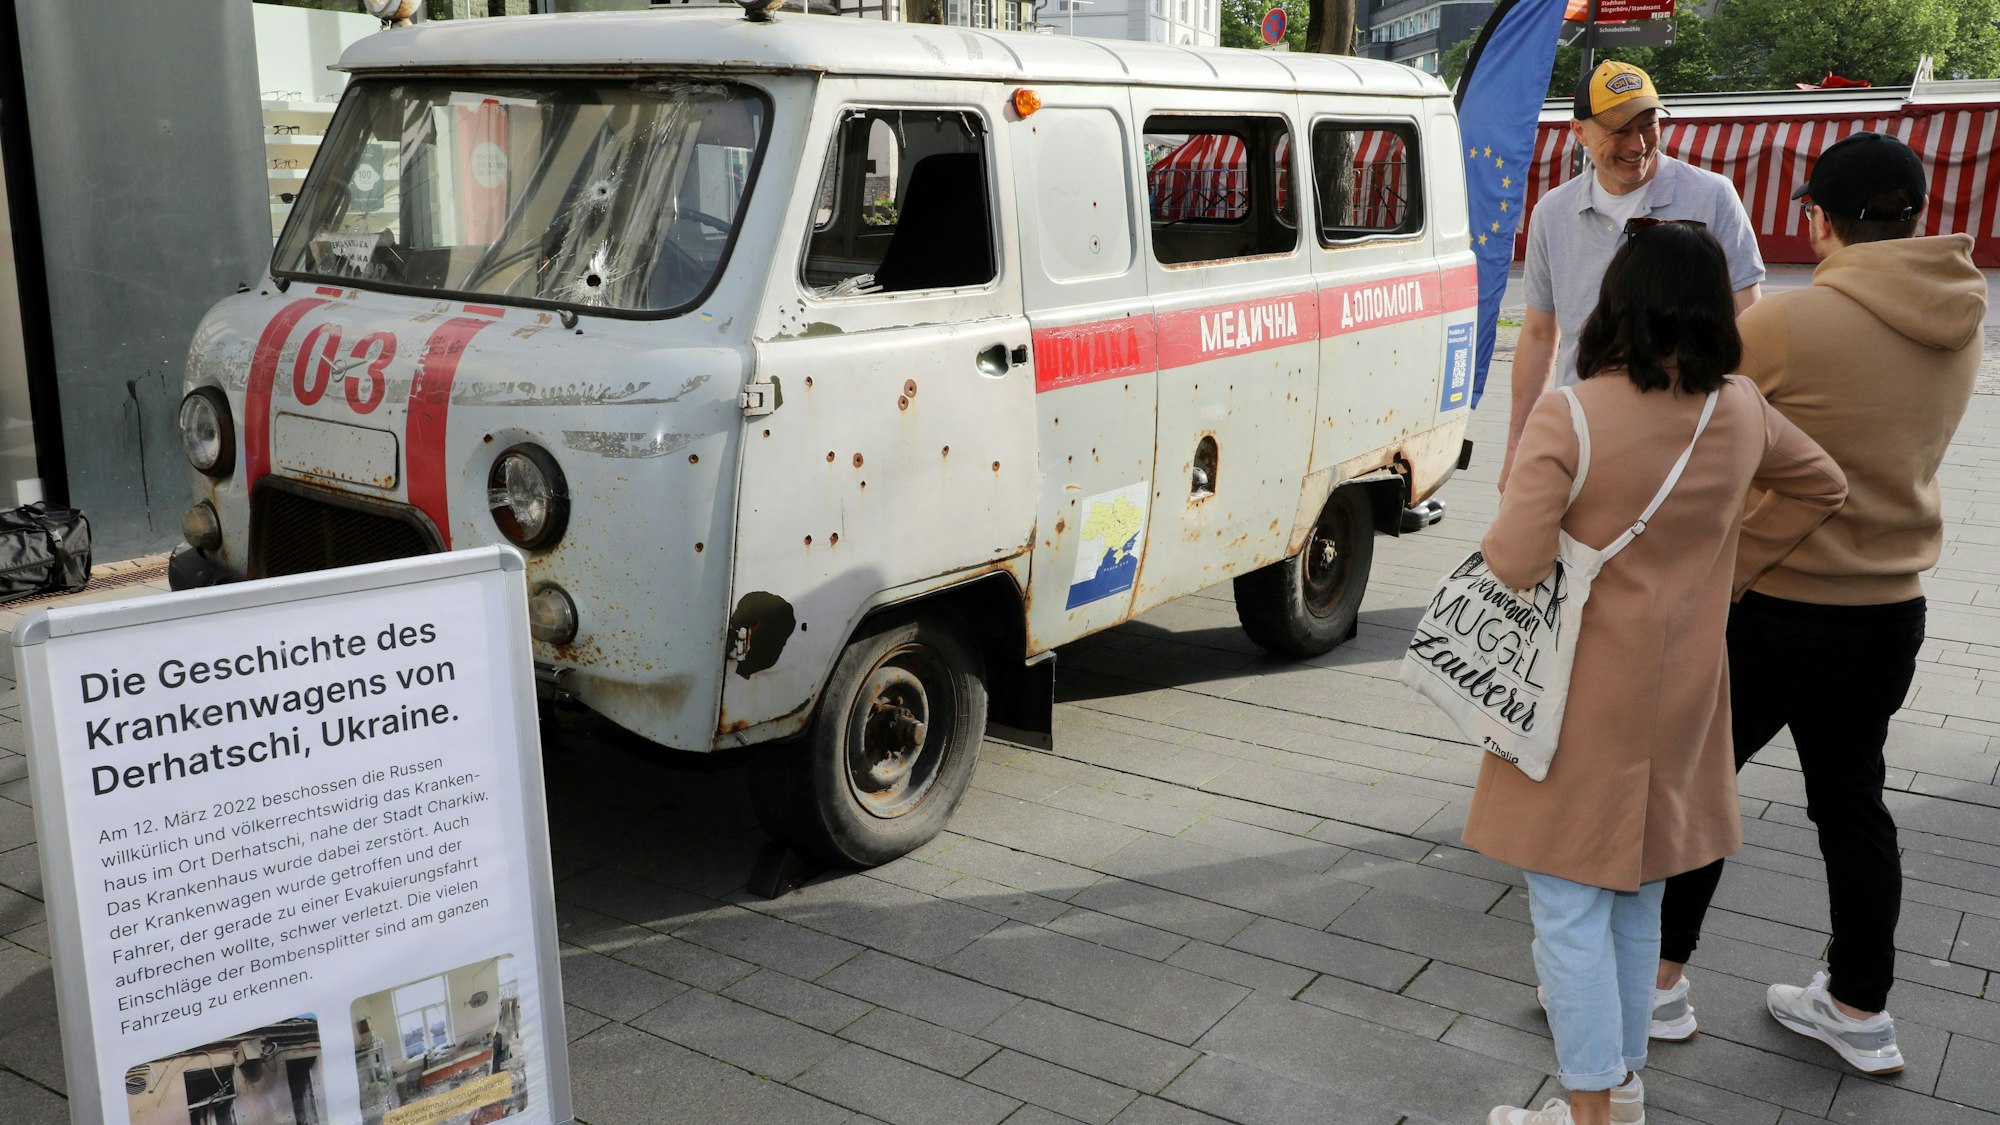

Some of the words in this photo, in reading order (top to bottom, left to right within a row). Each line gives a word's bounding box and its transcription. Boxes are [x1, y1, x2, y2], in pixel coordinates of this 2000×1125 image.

[359, 170, 372, 179] 100
[1200, 302, 1297, 352] МЕДИЧНА
[1341, 281, 1424, 329] ДОПОМОГА
[293, 322, 397, 415] 03
[80, 668, 146, 704] Die
[158, 634, 366, 689] Geschichte
[377, 623, 436, 651] des
[1409, 628, 1537, 732] Zauberer
[1428, 586, 1544, 691] MUGGEL
[86, 674, 387, 750] Krankenwagens
[396, 661, 455, 689] von
[91, 726, 310, 796] Derhatschi,
[321, 704, 458, 747] Ukraine.
[1491, 740, 1519, 764] Thalia
[99, 828, 127, 844] Am
[133, 819, 158, 835] 12.
[164, 810, 207, 829] März
[213, 797, 256, 818] 2022
[262, 777, 357, 807] beschossen
[362, 770, 385, 785] die
[390, 758, 442, 778] Russen
[101, 837, 188, 868] willkürlich
[194, 827, 225, 846] und
[231, 794, 378, 837] völkerrechtswidrig
[383, 788, 410, 802] das
[415, 773, 480, 795] Kranken-
[104, 873, 147, 893] haus
[153, 867, 173, 880] im
[179, 856, 206, 873] Ort
[212, 833, 304, 866] Derhatschi,
[310, 824, 348, 841] nahe
[353, 817, 378, 831] der
[383, 805, 423, 824] Stadt
[428, 792, 488, 813] Charkiw.
[107, 899, 141, 916] Das
[147, 869, 258, 906] Krankenhaus
[263, 856, 312, 876] wurde
[318, 840, 360, 862] dabei
[366, 826, 428, 851] zerstört.
[434, 816, 469, 834] Auch
[110, 923, 139, 940] der
[145, 889, 271, 931] Krankenwagen
[276, 874, 326, 896] wurde
[331, 856, 401, 885] getroffen
[407, 845, 433, 863] und
[439, 840, 462, 855] der
[113, 939, 174, 964] Fahrer,
[180, 929, 208, 946] der
[214, 913, 272, 940] gerade
[278, 906, 296, 920] zu
[301, 894, 339, 913] einer
[345, 857, 478, 901] Evakuierungsfahrt
[116, 952, 215, 988] aufbrechen
[221, 937, 274, 958] wollte,
[280, 918, 337, 942] schwer
[342, 899, 402, 924] verletzt.
[408, 891, 431, 906] Die
[436, 880, 478, 898] vielen
[118, 976, 212, 1011] Einschläge
[217, 965, 245, 982] der
[250, 930, 370, 973] Bombensplitter
[375, 918, 406, 937] sind
[411, 914, 433, 928] am
[438, 898, 488, 923] ganzen
[121, 1002, 202, 1035] Fahrzeug
[208, 994, 227, 1009] zu
[233, 971, 312, 1001] erkennen.
